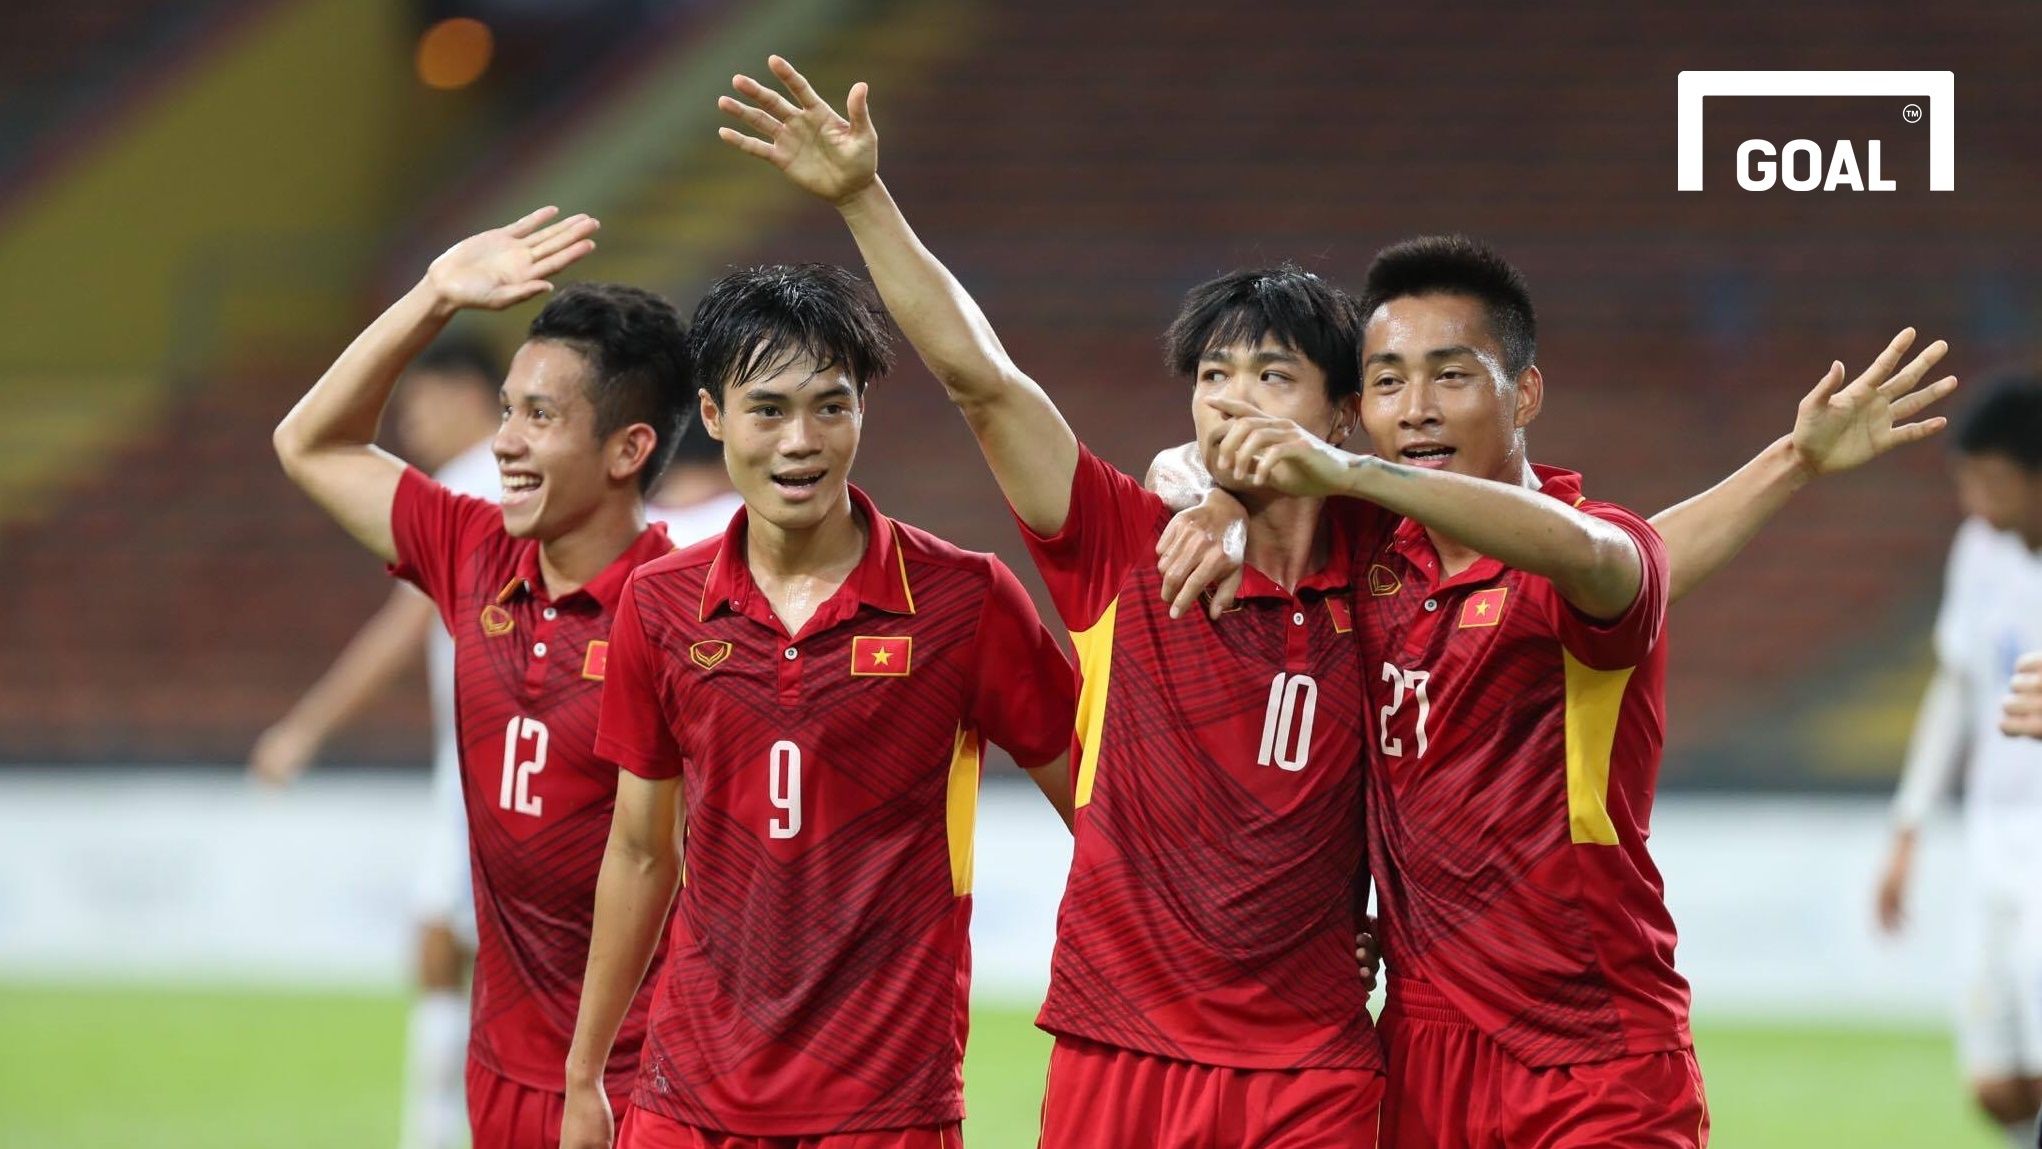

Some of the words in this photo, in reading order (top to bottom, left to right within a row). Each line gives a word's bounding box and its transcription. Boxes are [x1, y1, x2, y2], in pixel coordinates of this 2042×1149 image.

[1257, 671, 1318, 772] 10
[1379, 661, 1431, 759] 27
[499, 715, 549, 817] 12
[769, 740, 802, 839] 9
